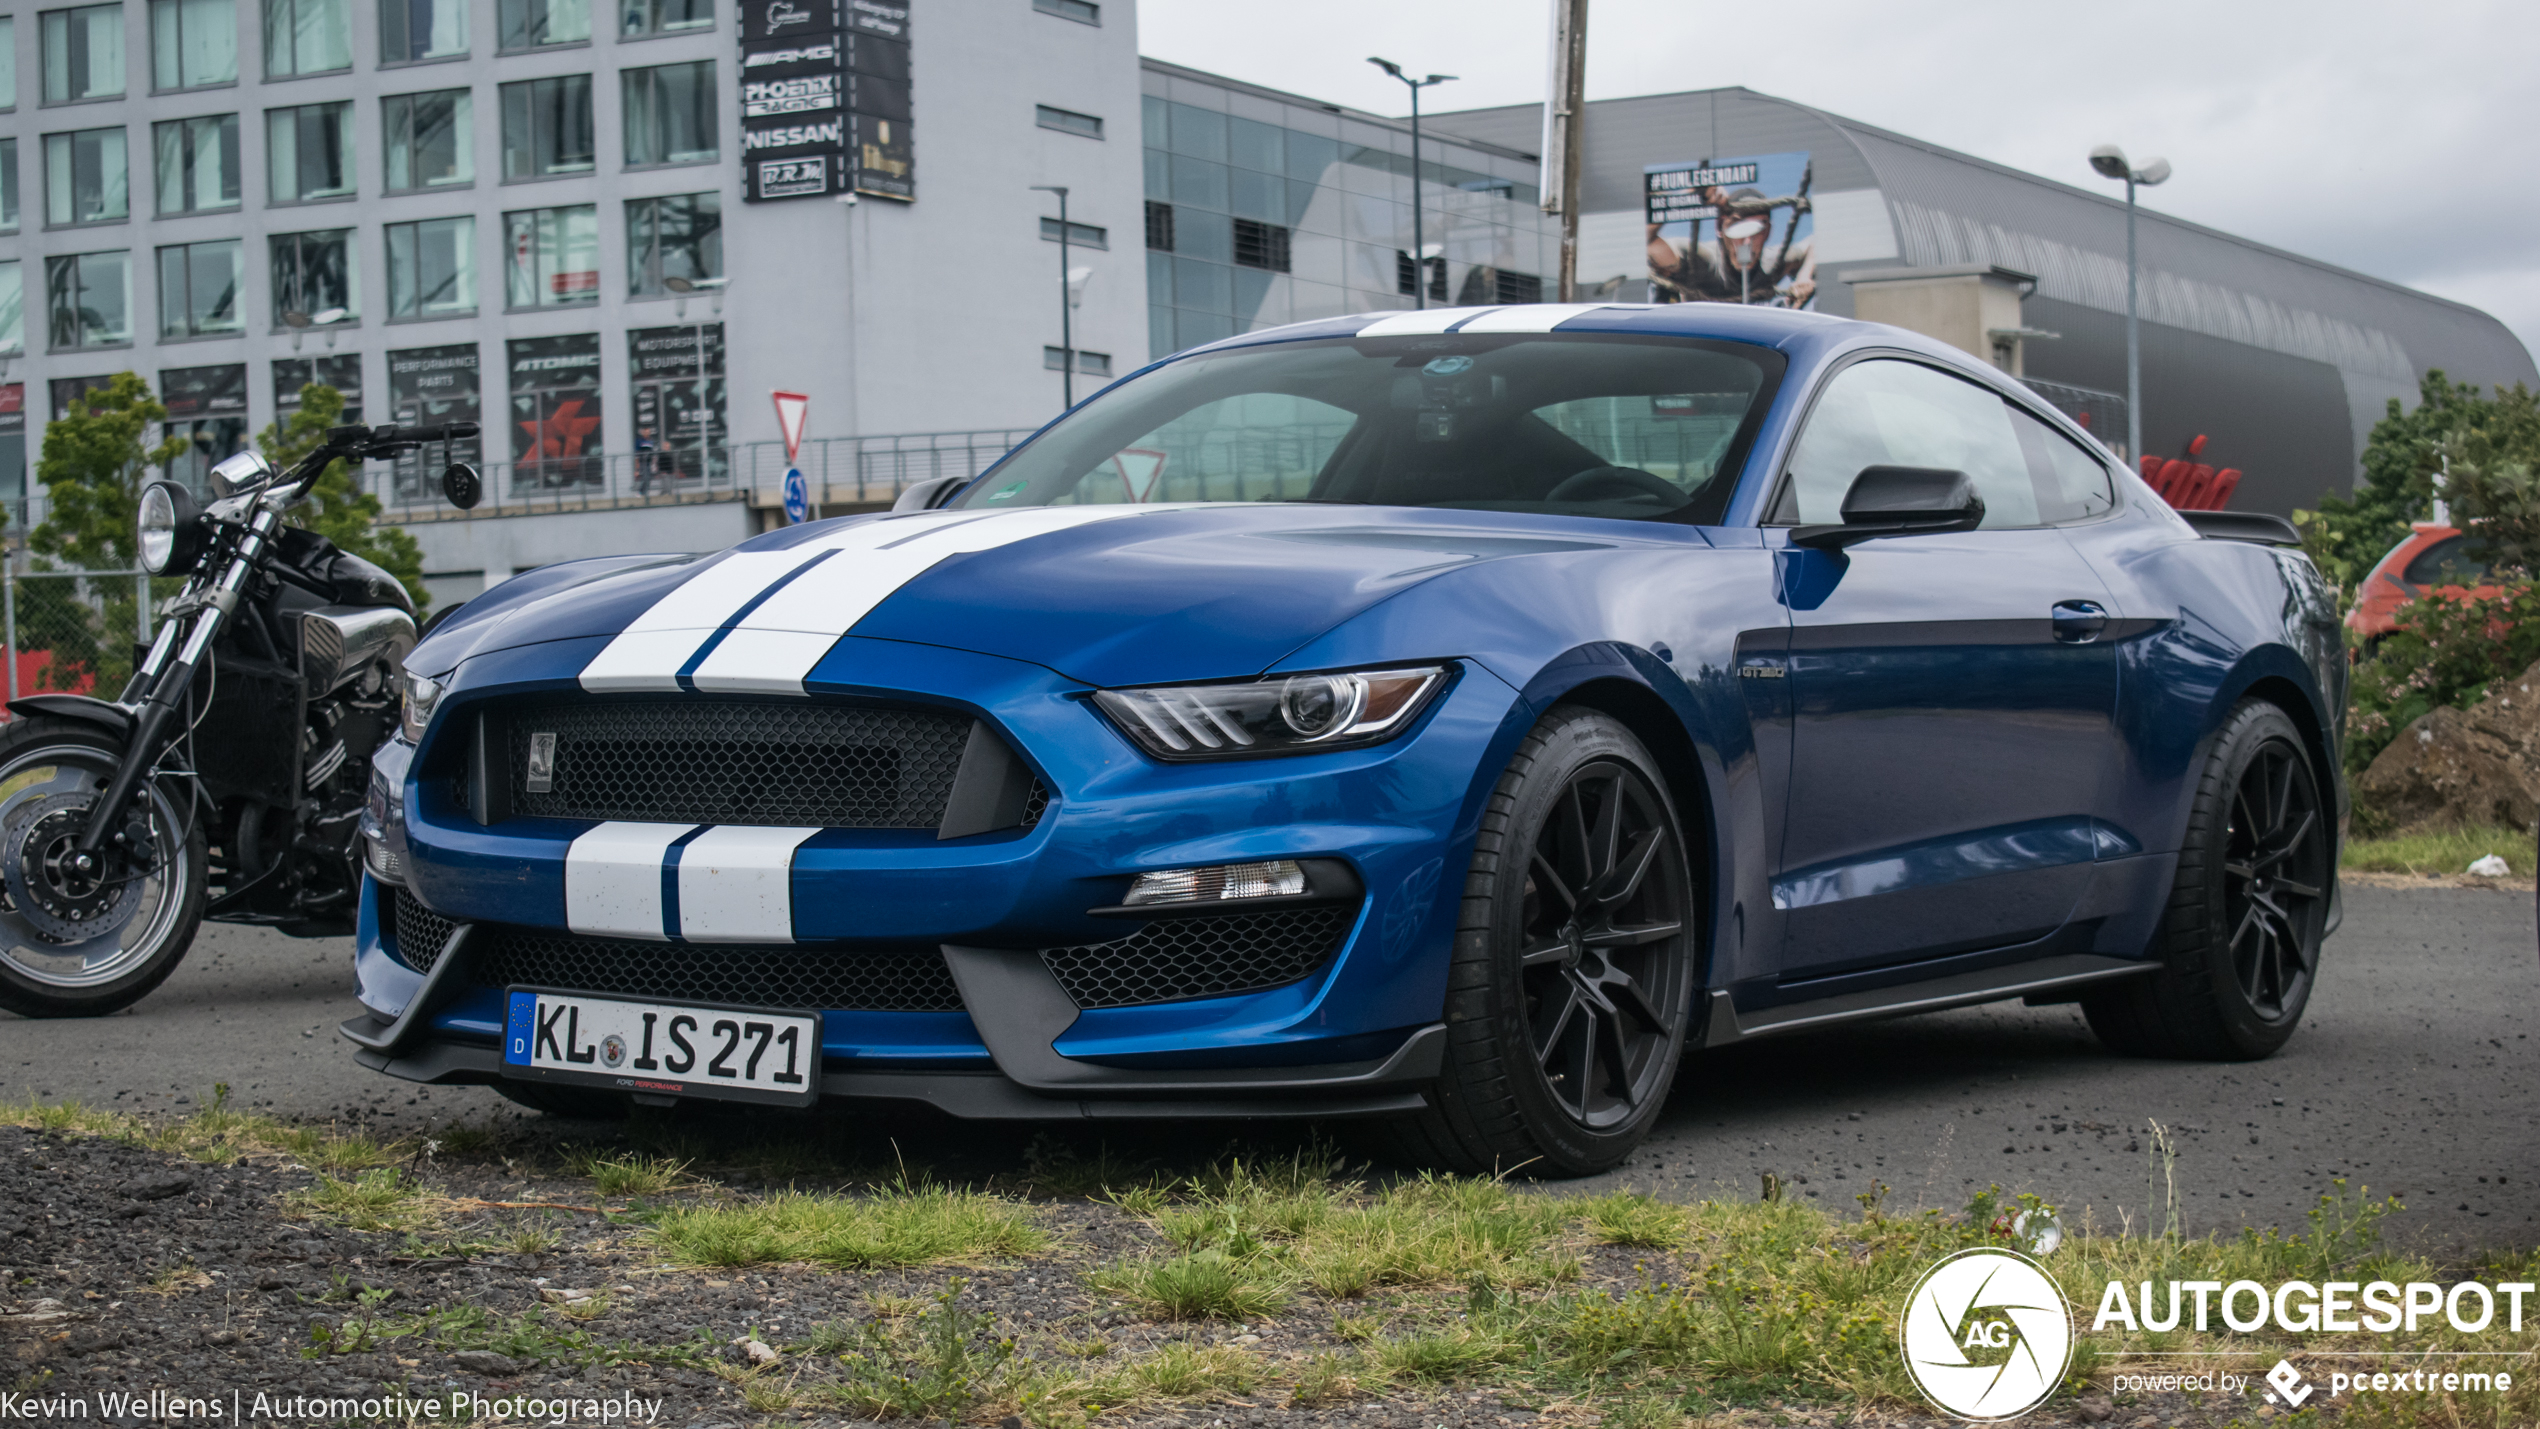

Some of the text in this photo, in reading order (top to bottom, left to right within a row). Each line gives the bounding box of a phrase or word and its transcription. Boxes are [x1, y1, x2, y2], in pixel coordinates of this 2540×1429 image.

[746, 123, 838, 150] NISSAN
[1651, 164, 1757, 191] #RUNLEGENDARY
[638, 335, 718, 351] MOTORSPRT
[393, 356, 477, 373] PERFORMANCE
[514, 354, 601, 372] ATOMIC
[644, 353, 713, 369] EQUIPMET
[417, 374, 454, 388] PARTS
[514, 1038, 525, 1054] D
[534, 1002, 803, 1085] KL IS 271
[616, 1078, 684, 1092] FORD PERFORMANCE
